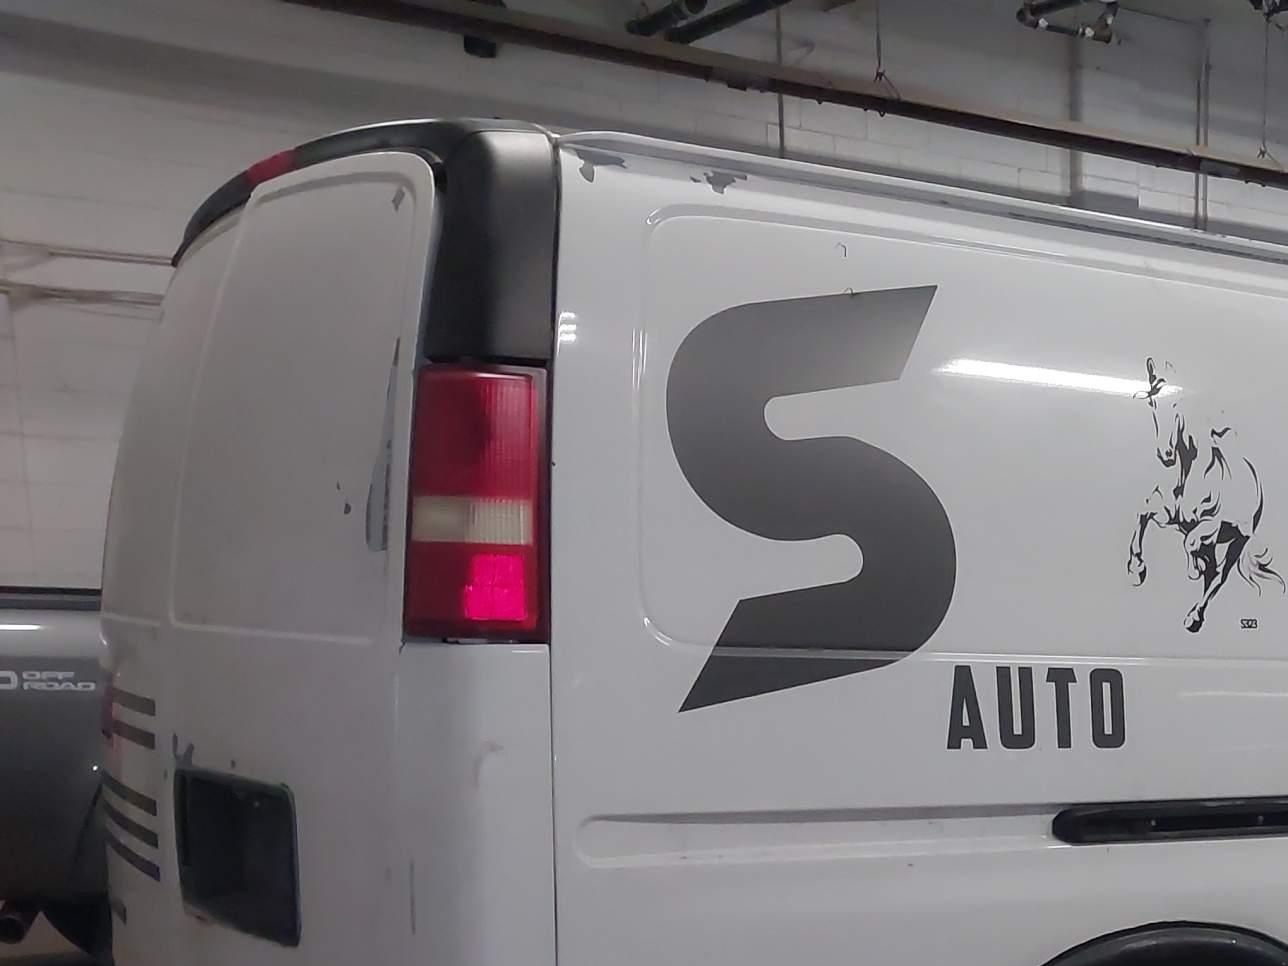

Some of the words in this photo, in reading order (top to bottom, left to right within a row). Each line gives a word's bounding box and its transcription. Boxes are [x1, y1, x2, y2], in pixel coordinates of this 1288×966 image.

[666, 285, 957, 713] S
[22, 671, 75, 680] OFF
[23, 681, 96, 691] ROAD
[947, 664, 1126, 750] AUTO
